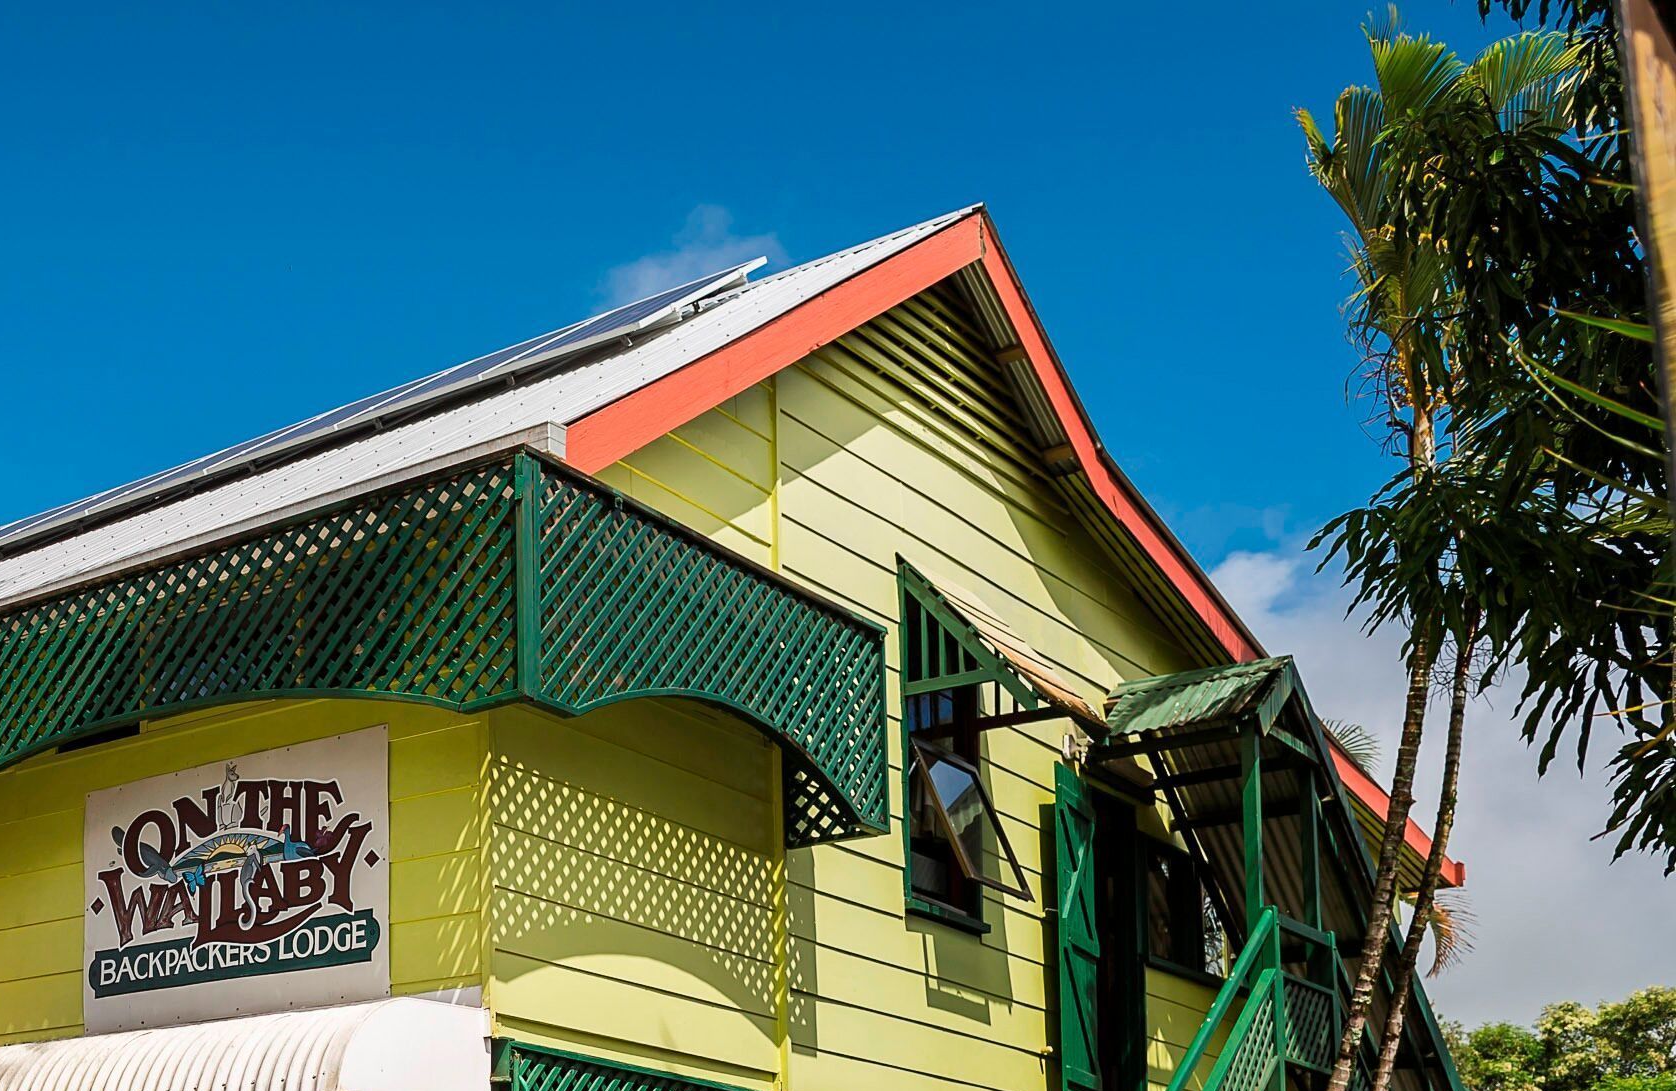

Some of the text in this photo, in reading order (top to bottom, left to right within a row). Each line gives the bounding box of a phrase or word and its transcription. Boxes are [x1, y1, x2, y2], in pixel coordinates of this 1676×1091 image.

[123, 779, 360, 878] ON THE
[98, 821, 373, 950] WALLABY
[100, 919, 367, 986] BACKPACKERS LODGE
